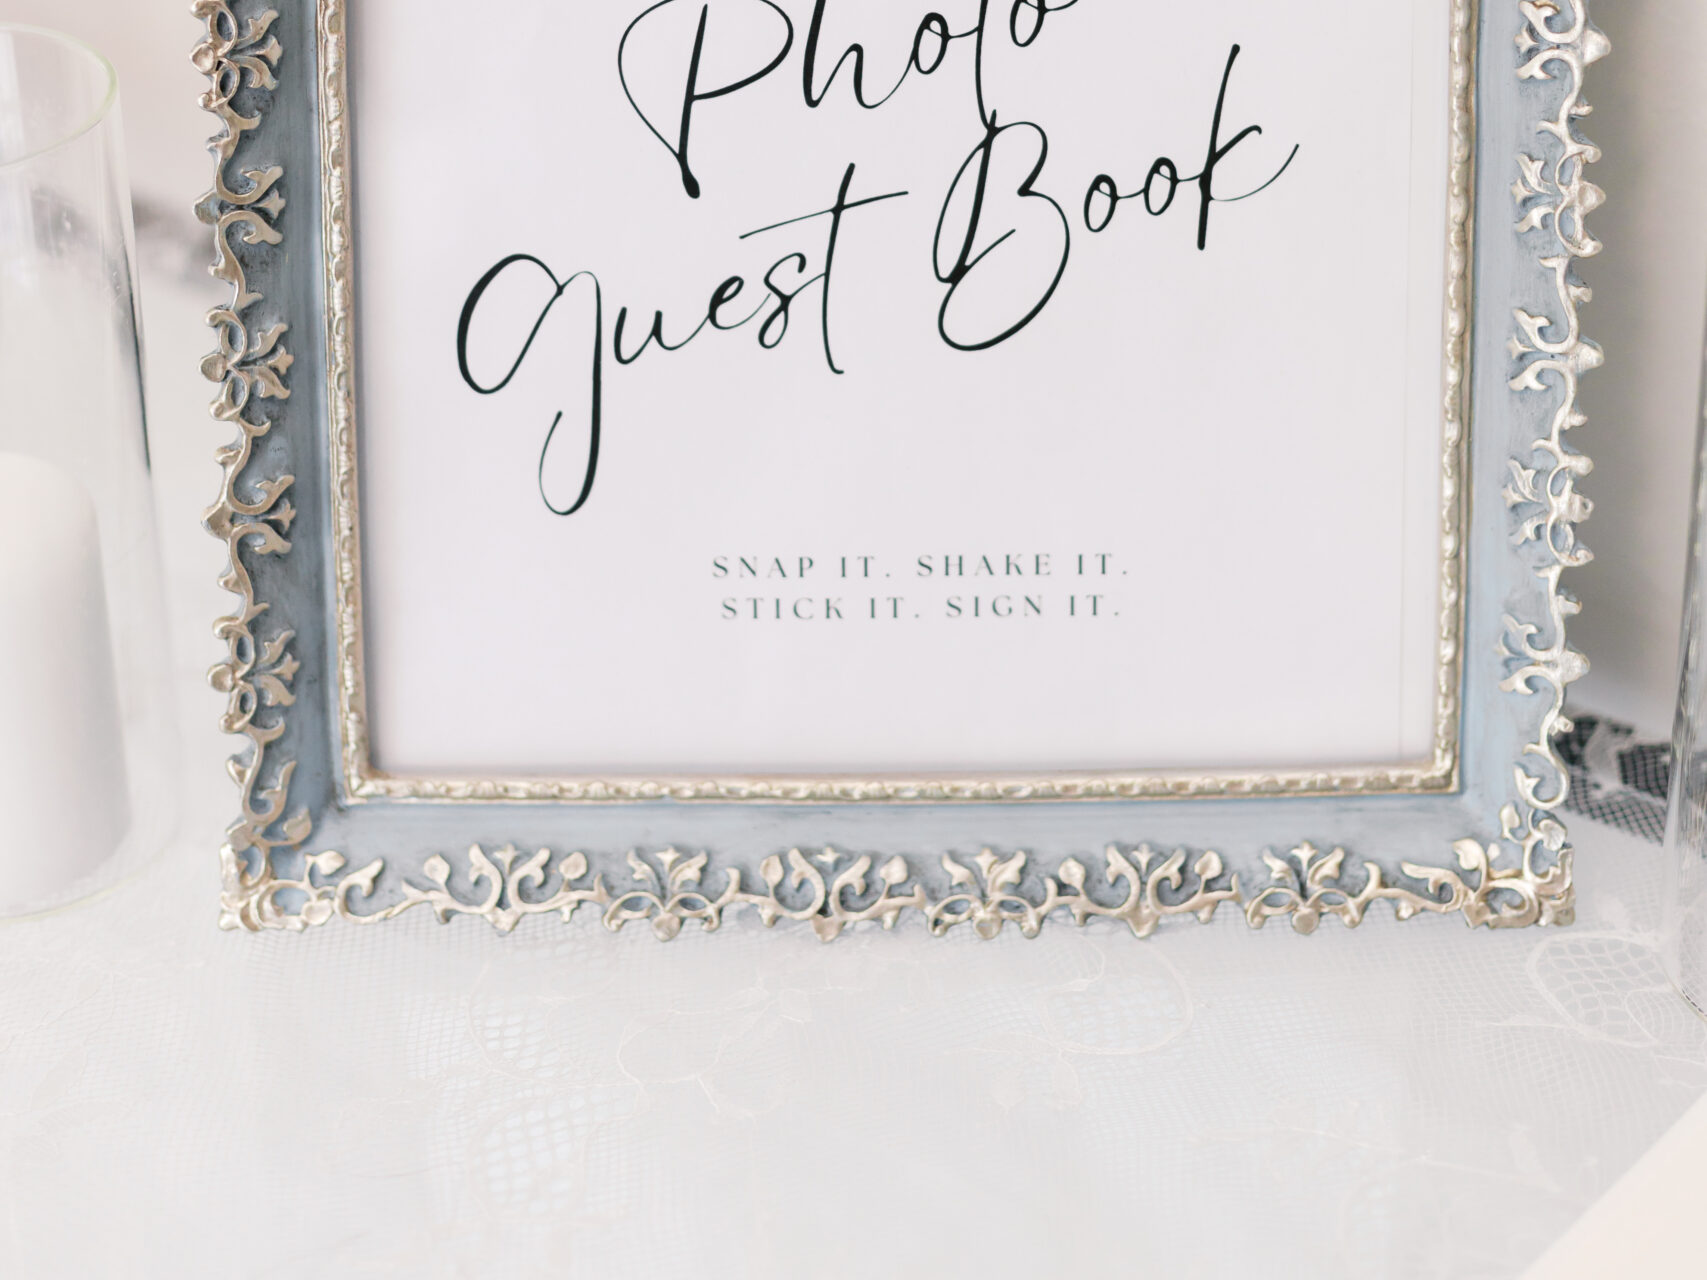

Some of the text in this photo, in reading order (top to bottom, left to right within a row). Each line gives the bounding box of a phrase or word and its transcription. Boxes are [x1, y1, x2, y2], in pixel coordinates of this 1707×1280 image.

[932, 42, 1301, 353] Book
[712, 552, 1129, 579] SNAP IT. SHAKE IT.
[721, 594, 1121, 620] STICK IT. SIGN IT.
